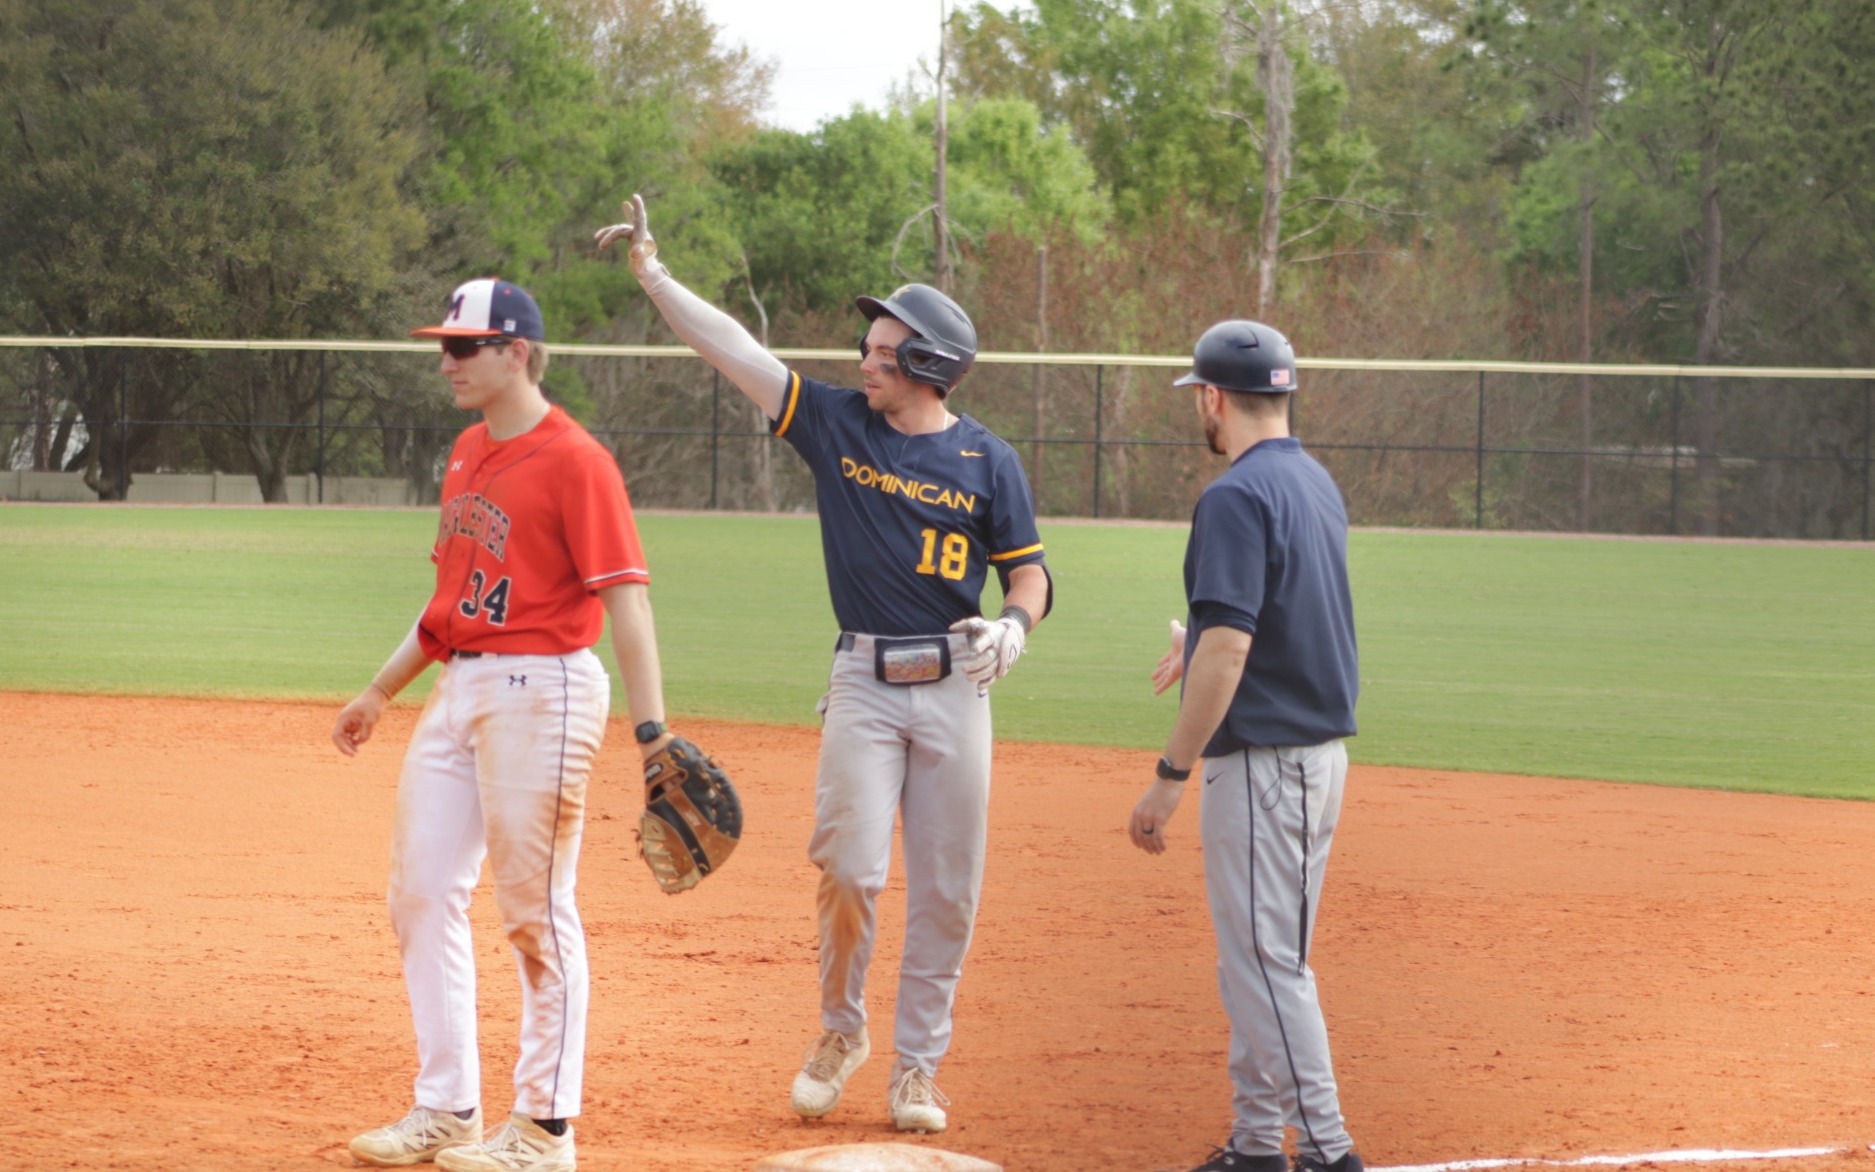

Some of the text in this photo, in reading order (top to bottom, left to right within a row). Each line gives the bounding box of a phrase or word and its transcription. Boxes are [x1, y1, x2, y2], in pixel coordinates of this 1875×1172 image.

[841, 457, 976, 513] DOMINICAN
[916, 528, 969, 581] 18
[459, 568, 512, 627] 34
